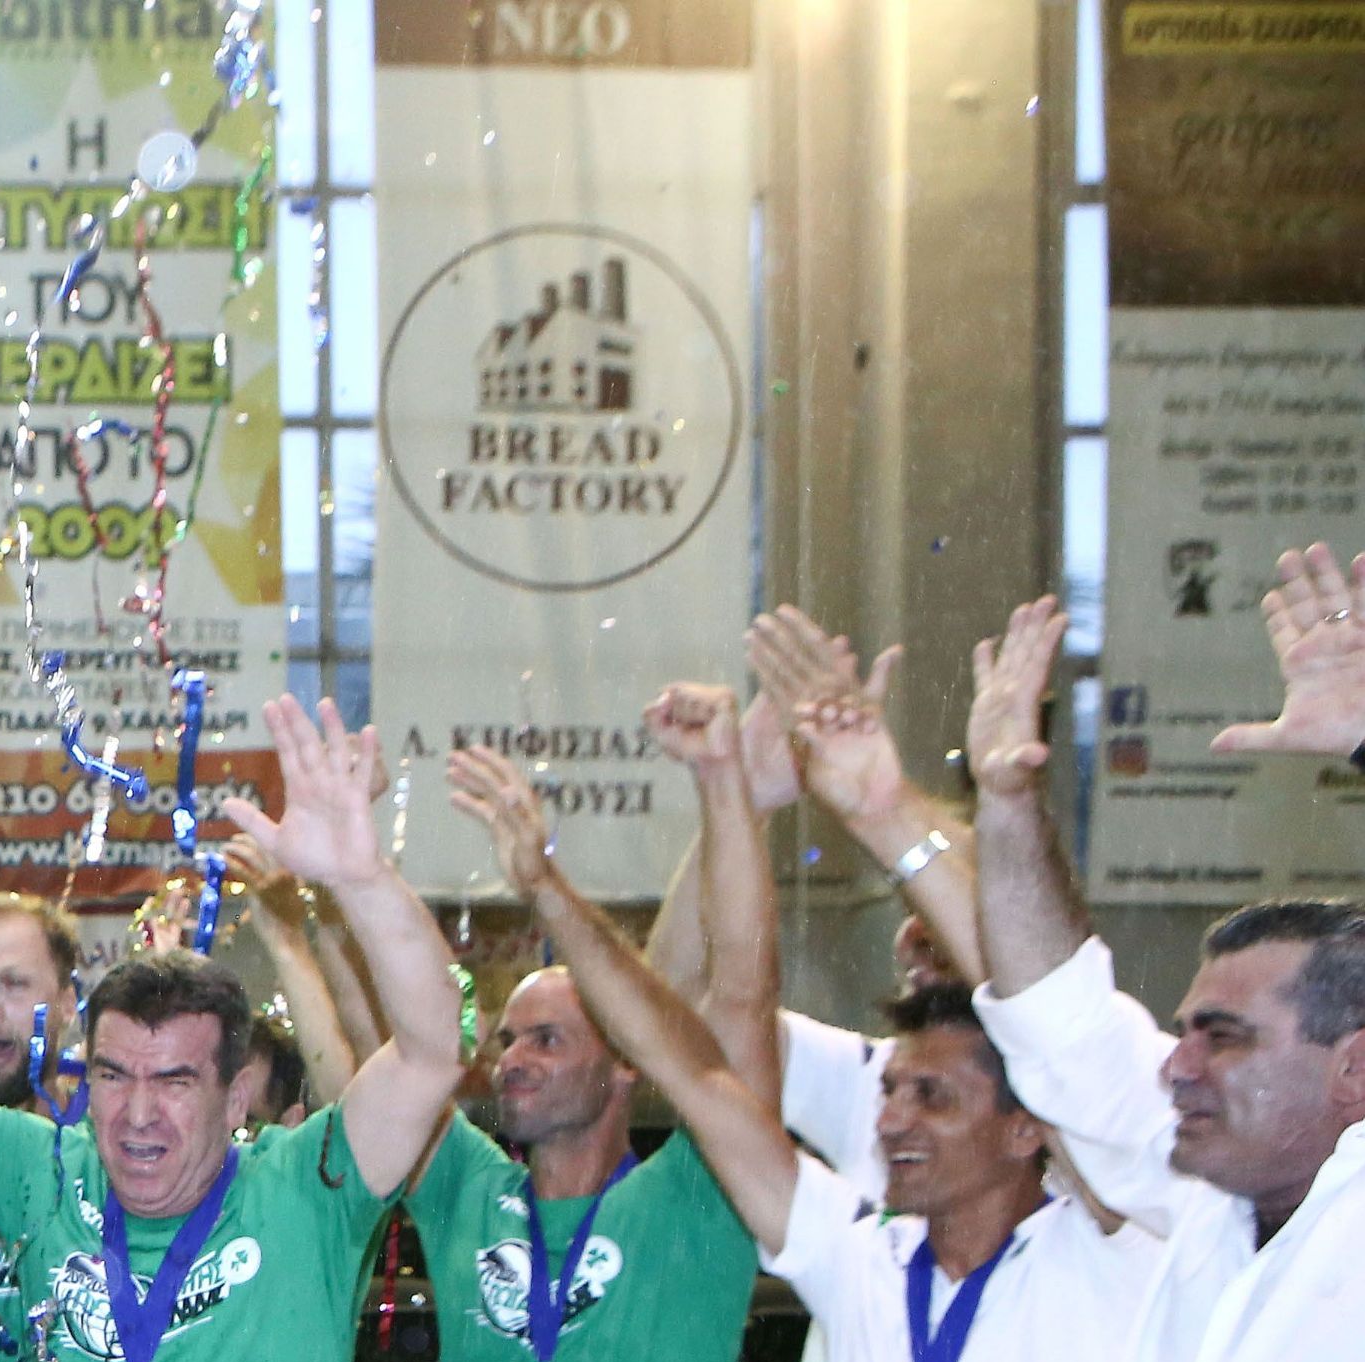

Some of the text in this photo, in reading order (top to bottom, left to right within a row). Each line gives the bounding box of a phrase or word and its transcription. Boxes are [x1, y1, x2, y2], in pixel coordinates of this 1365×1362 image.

[30, 272, 150, 325] ΠΟΥ
[469, 423, 663, 465] BREAD
[442, 473, 688, 514] FACTORY
